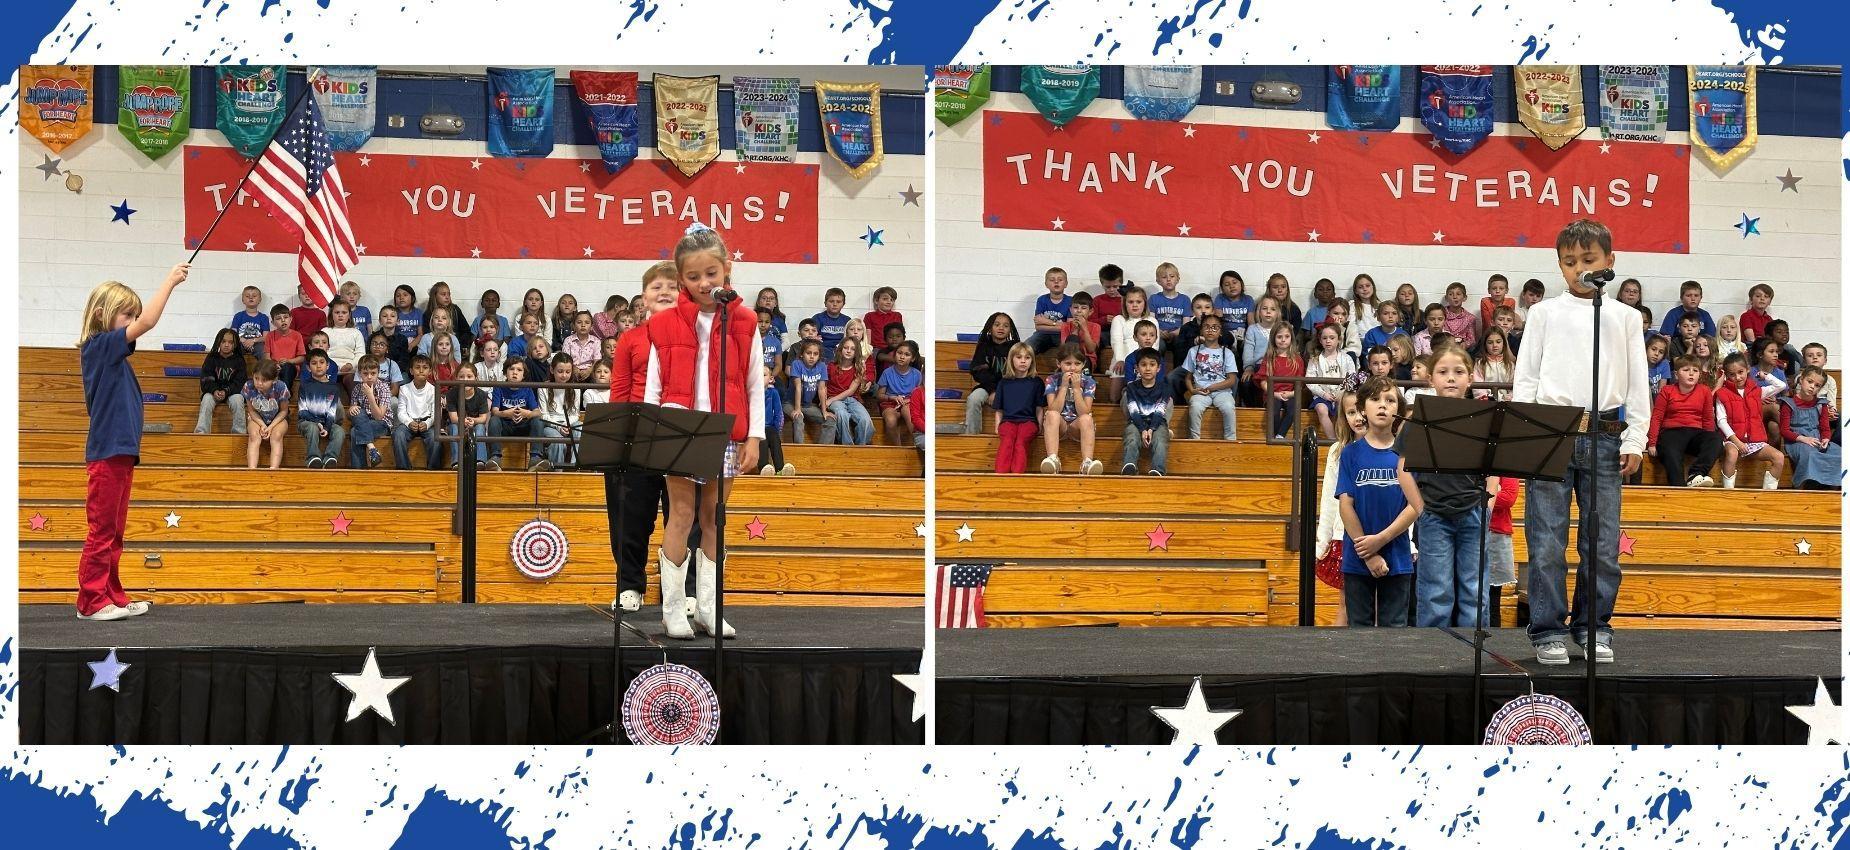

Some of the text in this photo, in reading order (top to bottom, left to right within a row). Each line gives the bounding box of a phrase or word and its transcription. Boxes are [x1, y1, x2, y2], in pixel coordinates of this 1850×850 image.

[1608, 65, 1658, 76] 2023-2024
[1041, 78, 1080, 87] 2018-2019
[1525, 72, 1570, 84] 2022-2023
[237, 78, 277, 93] KIDS
[331, 81, 368, 94] KIDS
[947, 79, 968, 88] HEART
[1690, 79, 1750, 93] 2024-2025
[1354, 87, 1390, 96] HEART
[237, 92, 277, 102] HEART
[331, 94, 368, 103] HEART
[585, 93, 626, 102] 2021-2022
[743, 93, 788, 102] 2023-2024
[666, 102, 707, 112] 2022-2023
[821, 103, 875, 115] 2024-2025
[1541, 102, 1569, 113] KIDS
[1620, 99, 1650, 109] KIDS
[1620, 109, 1650, 117] HEART
[512, 117, 545, 126] HEART
[1448, 118, 1486, 127] HEART
[754, 124, 782, 132] KIDS
[1711, 124, 1743, 133] HEART
[680, 131, 706, 141] KIDS
[1006, 148, 1658, 215] THANK YOU VETERANS!
[400, 184, 790, 230] YOU VETERANS!
